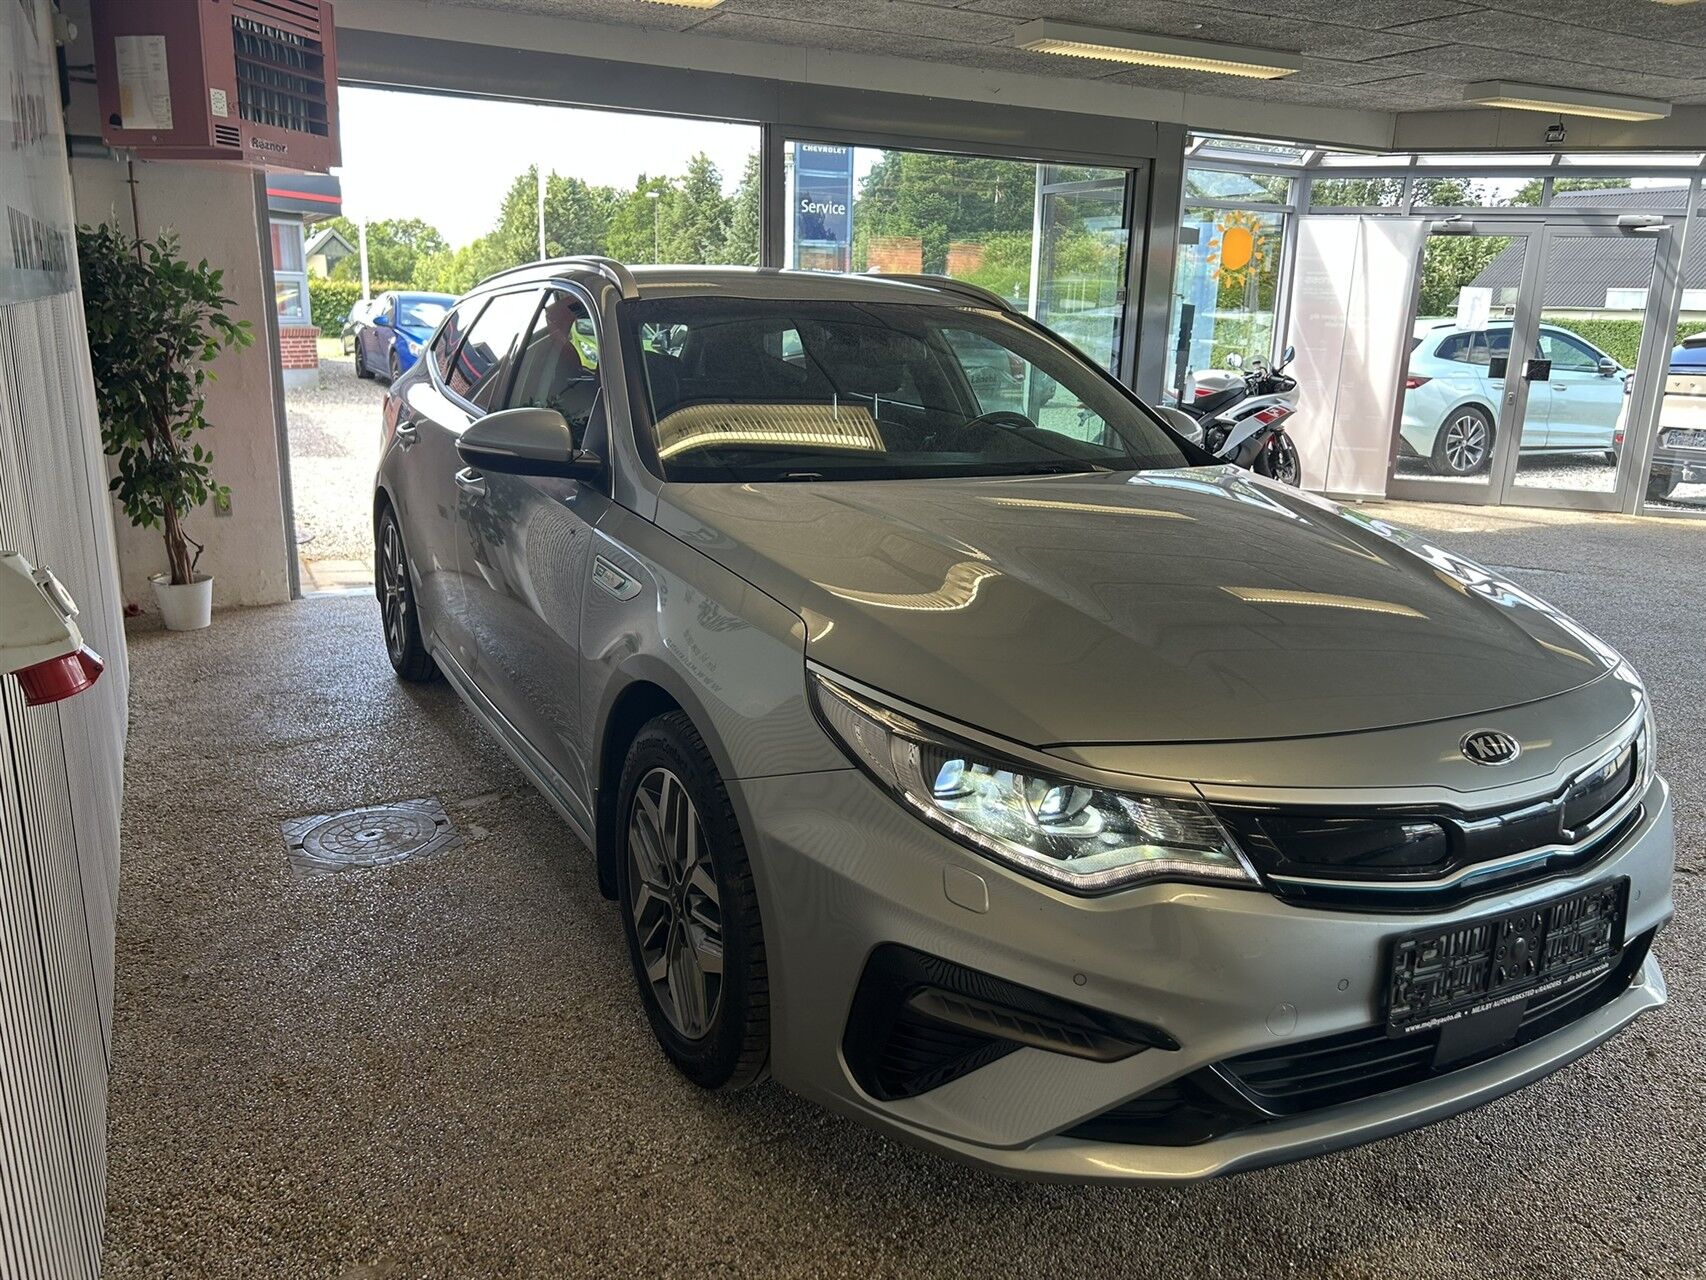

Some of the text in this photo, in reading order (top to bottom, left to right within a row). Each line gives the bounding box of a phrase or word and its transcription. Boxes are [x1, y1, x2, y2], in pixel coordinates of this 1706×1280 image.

[802, 144, 847, 154] CHEVROLET
[801, 199, 845, 215] Service
[1469, 734, 1515, 759] KIA
